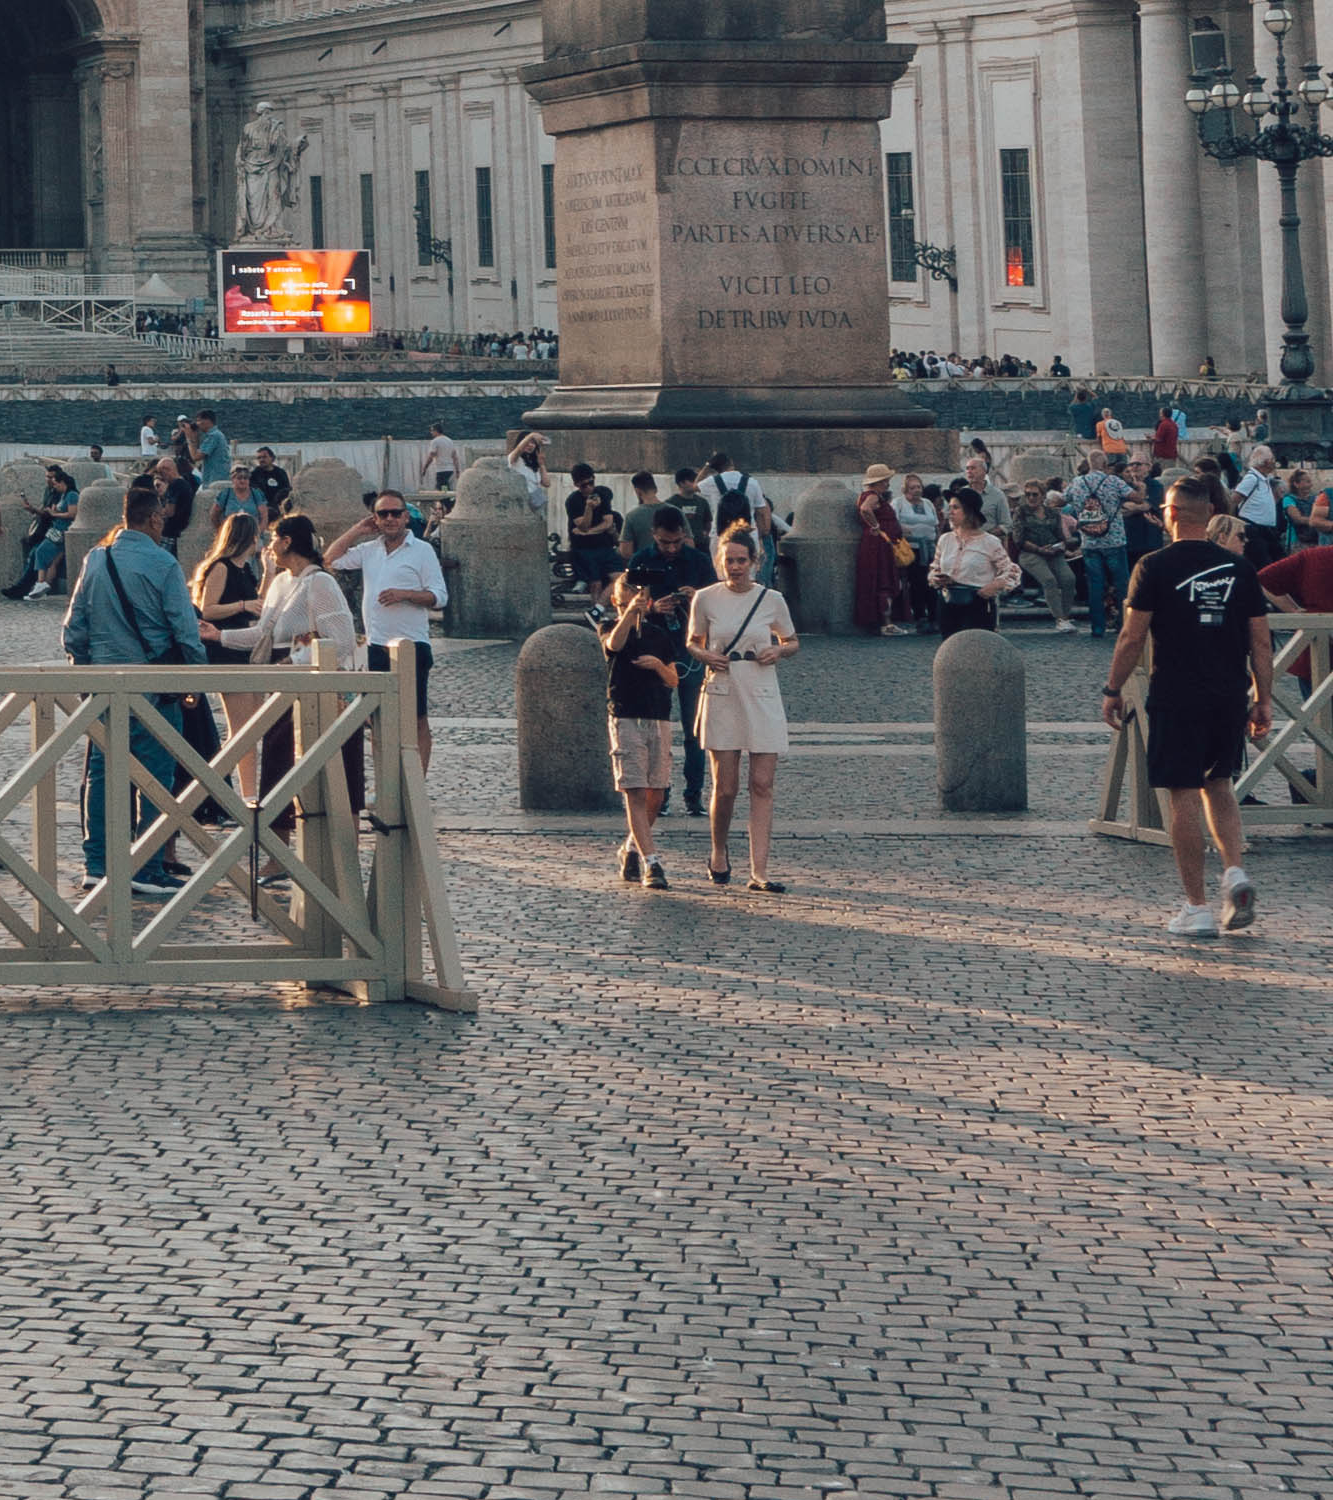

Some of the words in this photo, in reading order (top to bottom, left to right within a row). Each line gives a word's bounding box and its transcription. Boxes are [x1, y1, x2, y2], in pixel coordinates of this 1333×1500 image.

[672, 224, 750, 244] PARTES
[719, 275, 782, 295] VICIT
[789, 276, 831, 296] LEO
